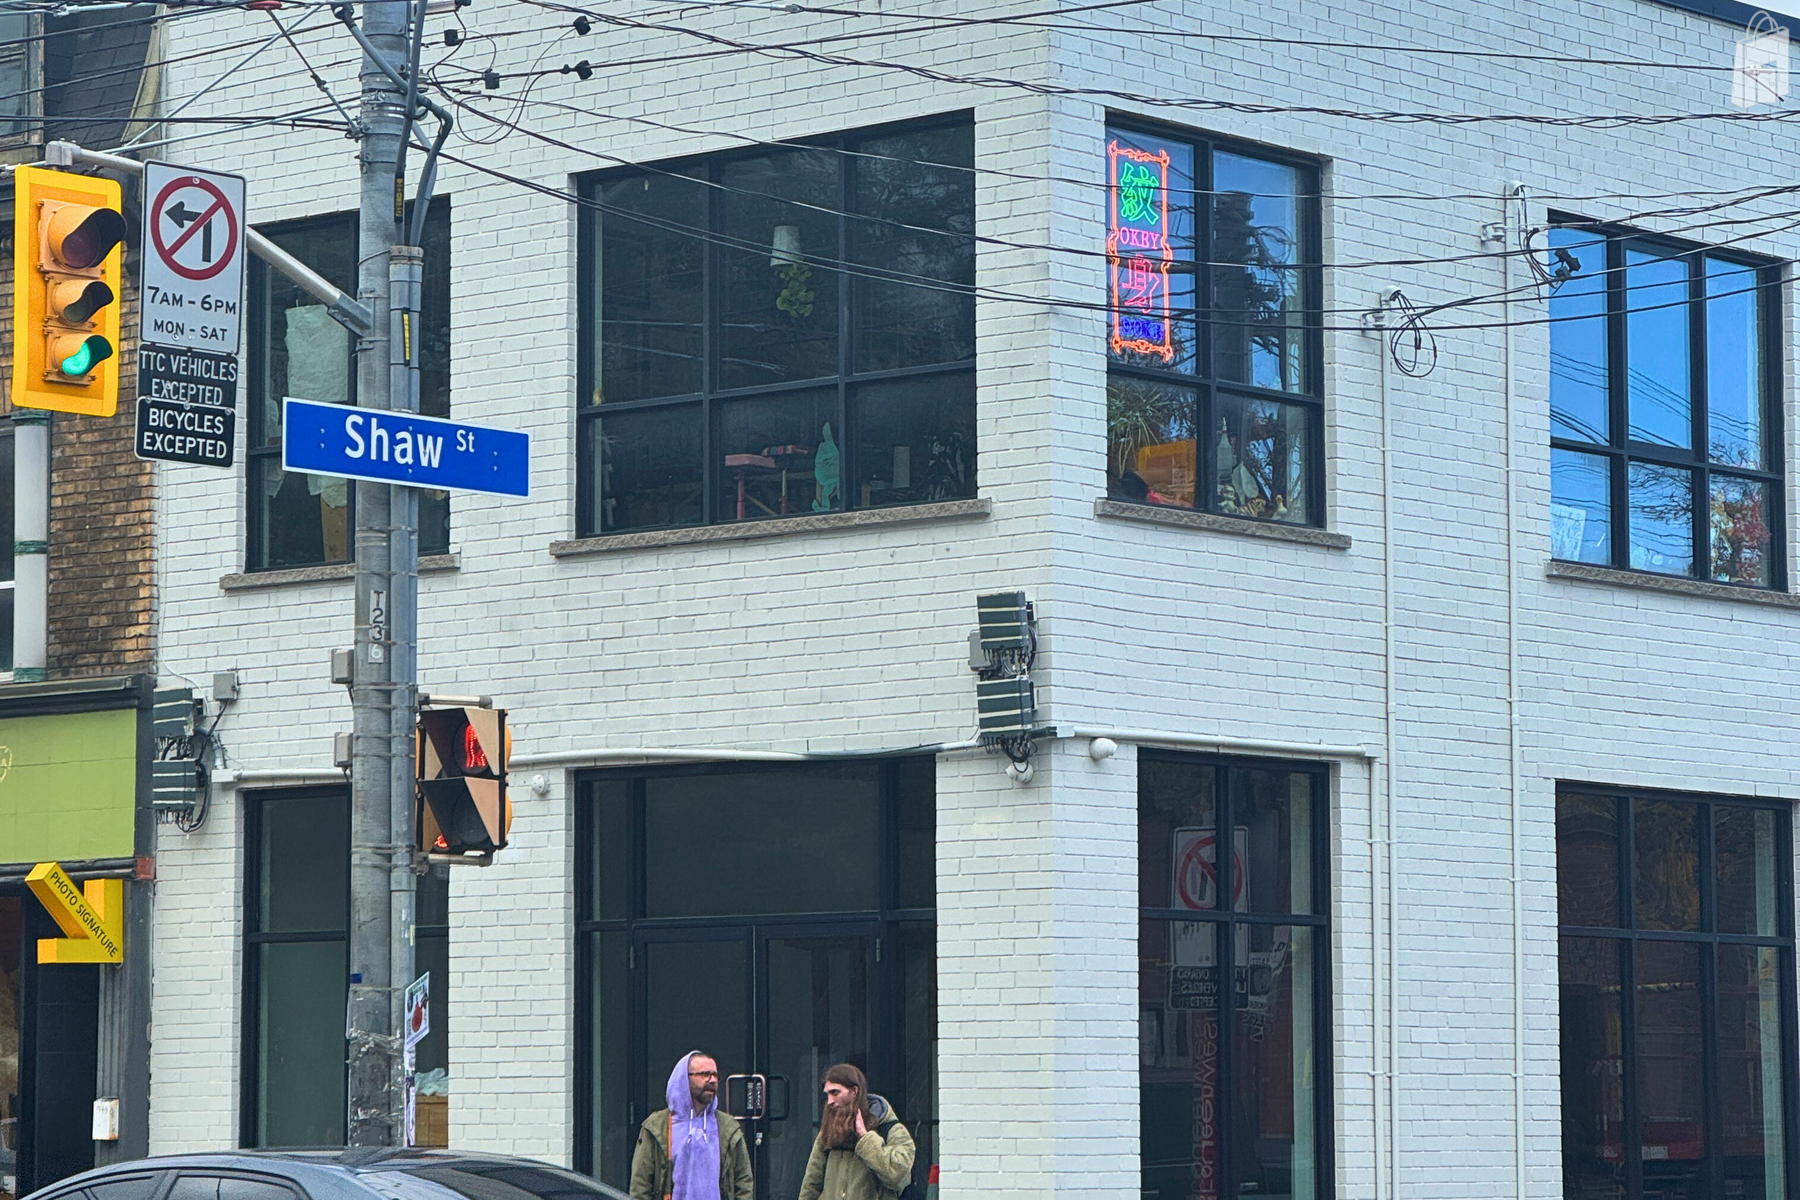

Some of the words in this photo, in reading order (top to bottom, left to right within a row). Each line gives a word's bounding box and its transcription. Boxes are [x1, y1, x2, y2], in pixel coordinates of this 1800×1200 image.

[1119, 226, 1160, 250] OKEY
[1121, 253, 1160, 314] 身
[147, 286, 183, 308] 7AM
[200, 294, 236, 315] 6PM
[153, 318, 185, 336] MON
[200, 325, 228, 342] SAT
[140, 350, 166, 372] TTC
[169, 354, 237, 382] VEHICLES
[151, 378, 223, 406] EXCEPTED
[148, 407, 224, 435] BICYCLES
[143, 431, 227, 459] EXCEPTED
[344, 414, 443, 468] Shaw
[456, 429, 475, 453] St
[50, 871, 78, 906] PHOTO
[75, 904, 118, 957] SIGNATURE
